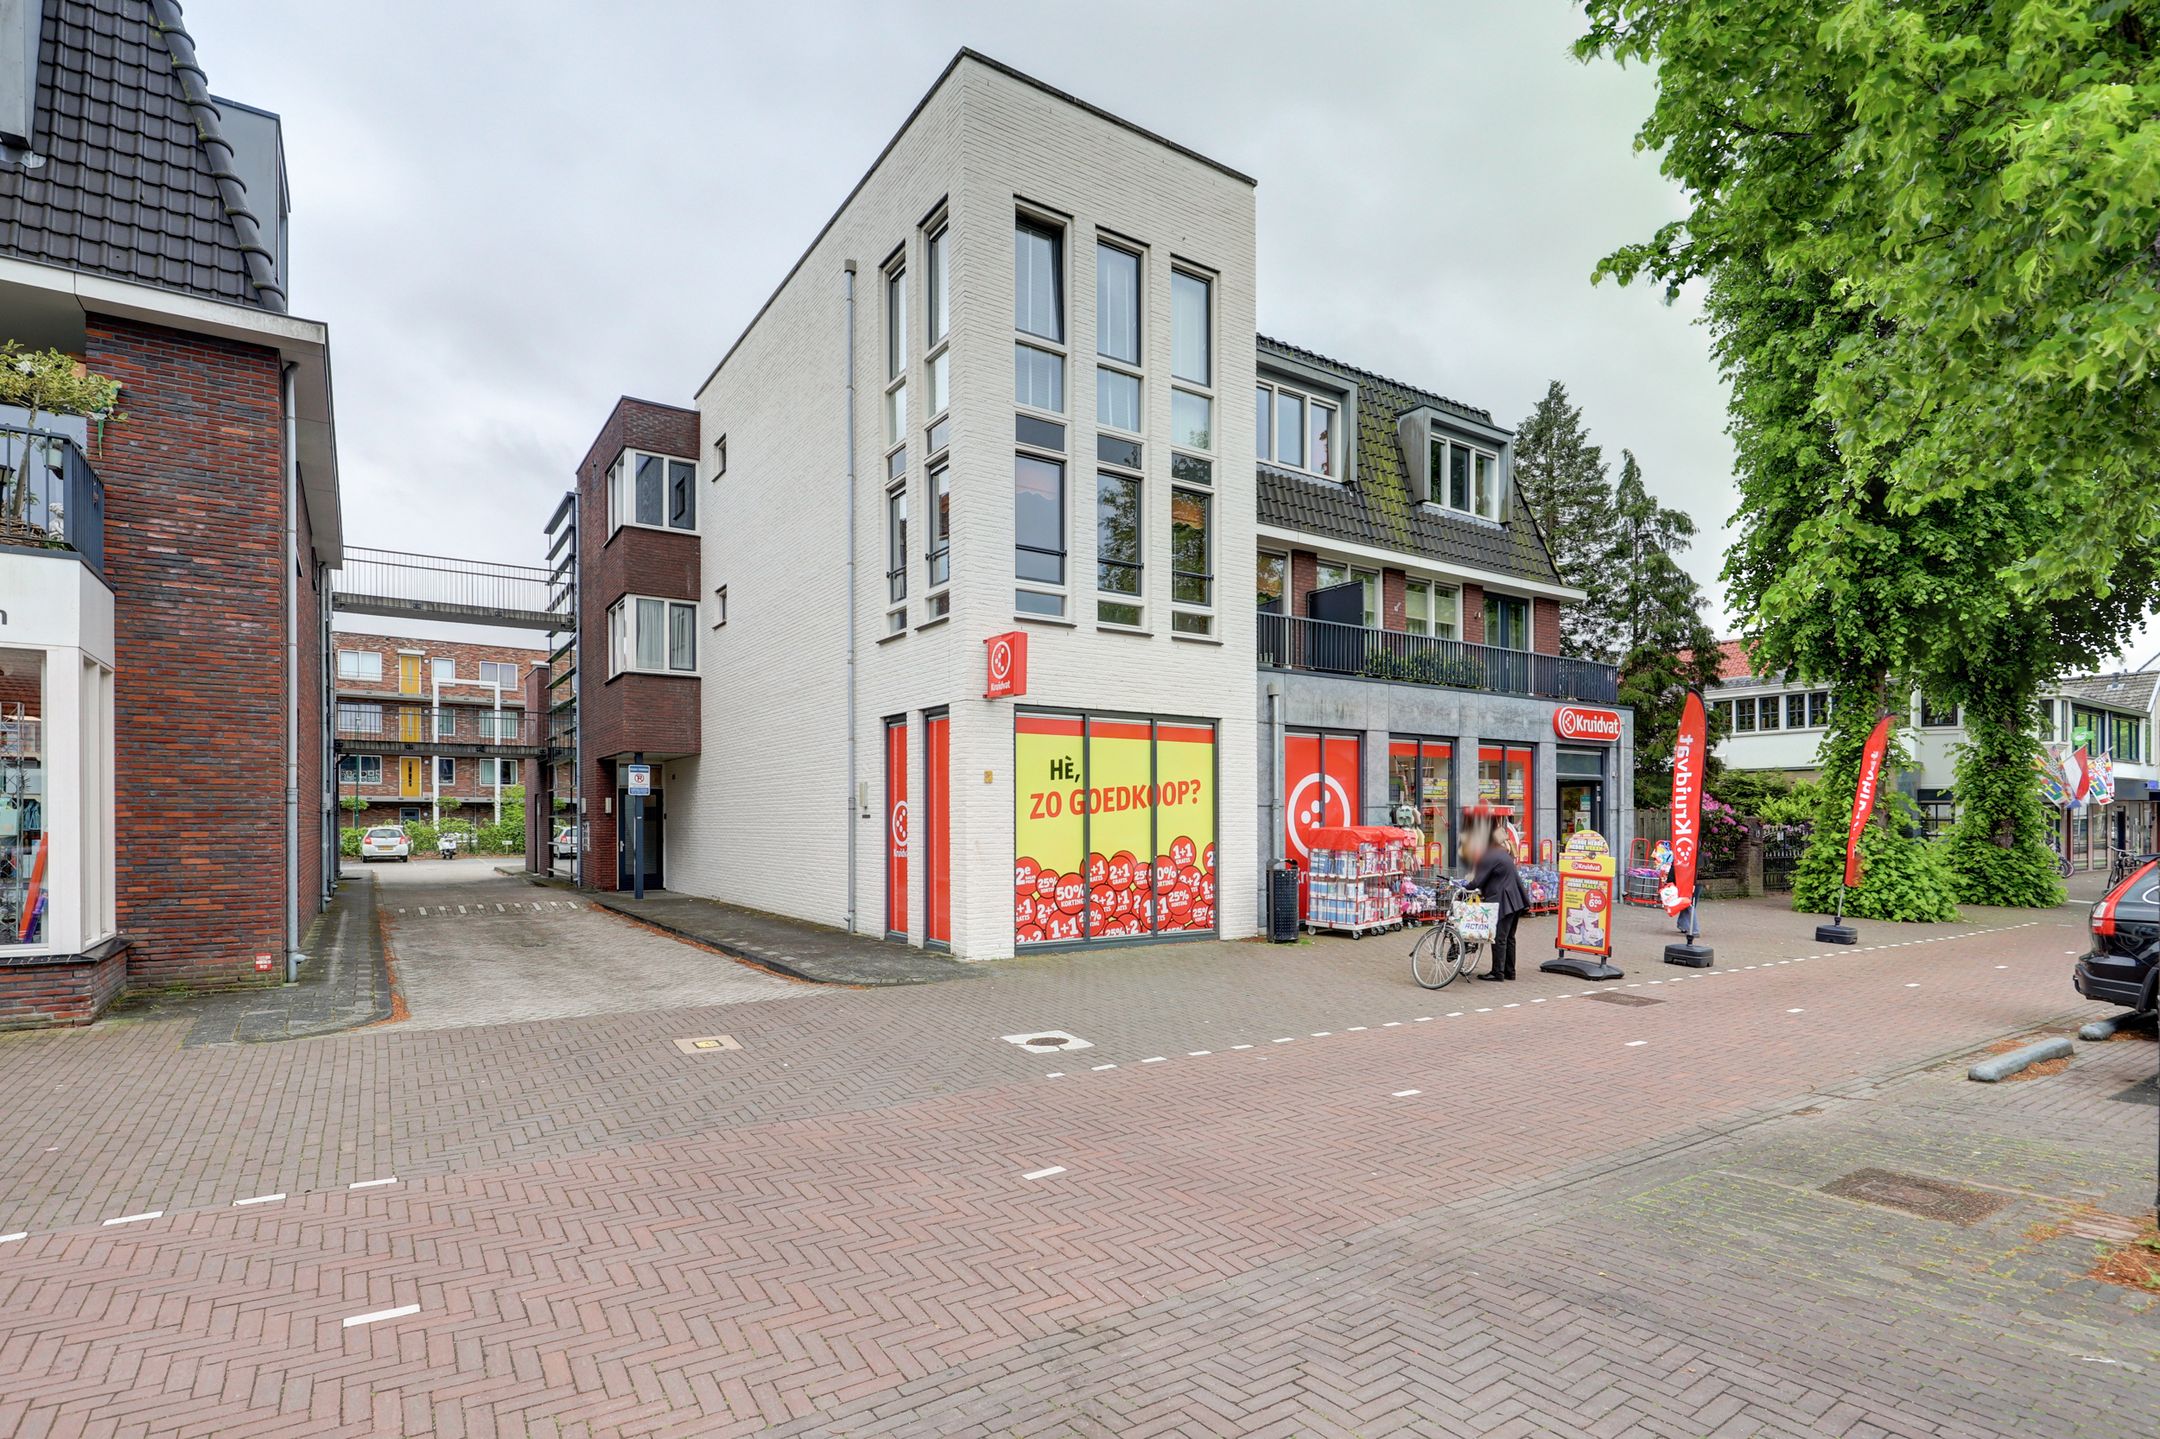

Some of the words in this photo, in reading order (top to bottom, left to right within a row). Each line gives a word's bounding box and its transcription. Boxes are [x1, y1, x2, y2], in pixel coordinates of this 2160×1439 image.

[991, 681, 1011, 691] Kruidvat
[1576, 714, 1619, 735] Kruidvat
[1050, 755, 1081, 783] HÈ,
[1029, 791, 1062, 820] ZO
[1069, 779, 1201, 816] GOEDKOOP?
[1173, 843, 1193, 860] 1+1
[1090, 860, 1106, 875] +1
[1109, 863, 1130, 880] 2+1
[1169, 890, 1190, 902] 25%
[1016, 899, 1032, 914] +1
[1050, 917, 1079, 939] 1+1
